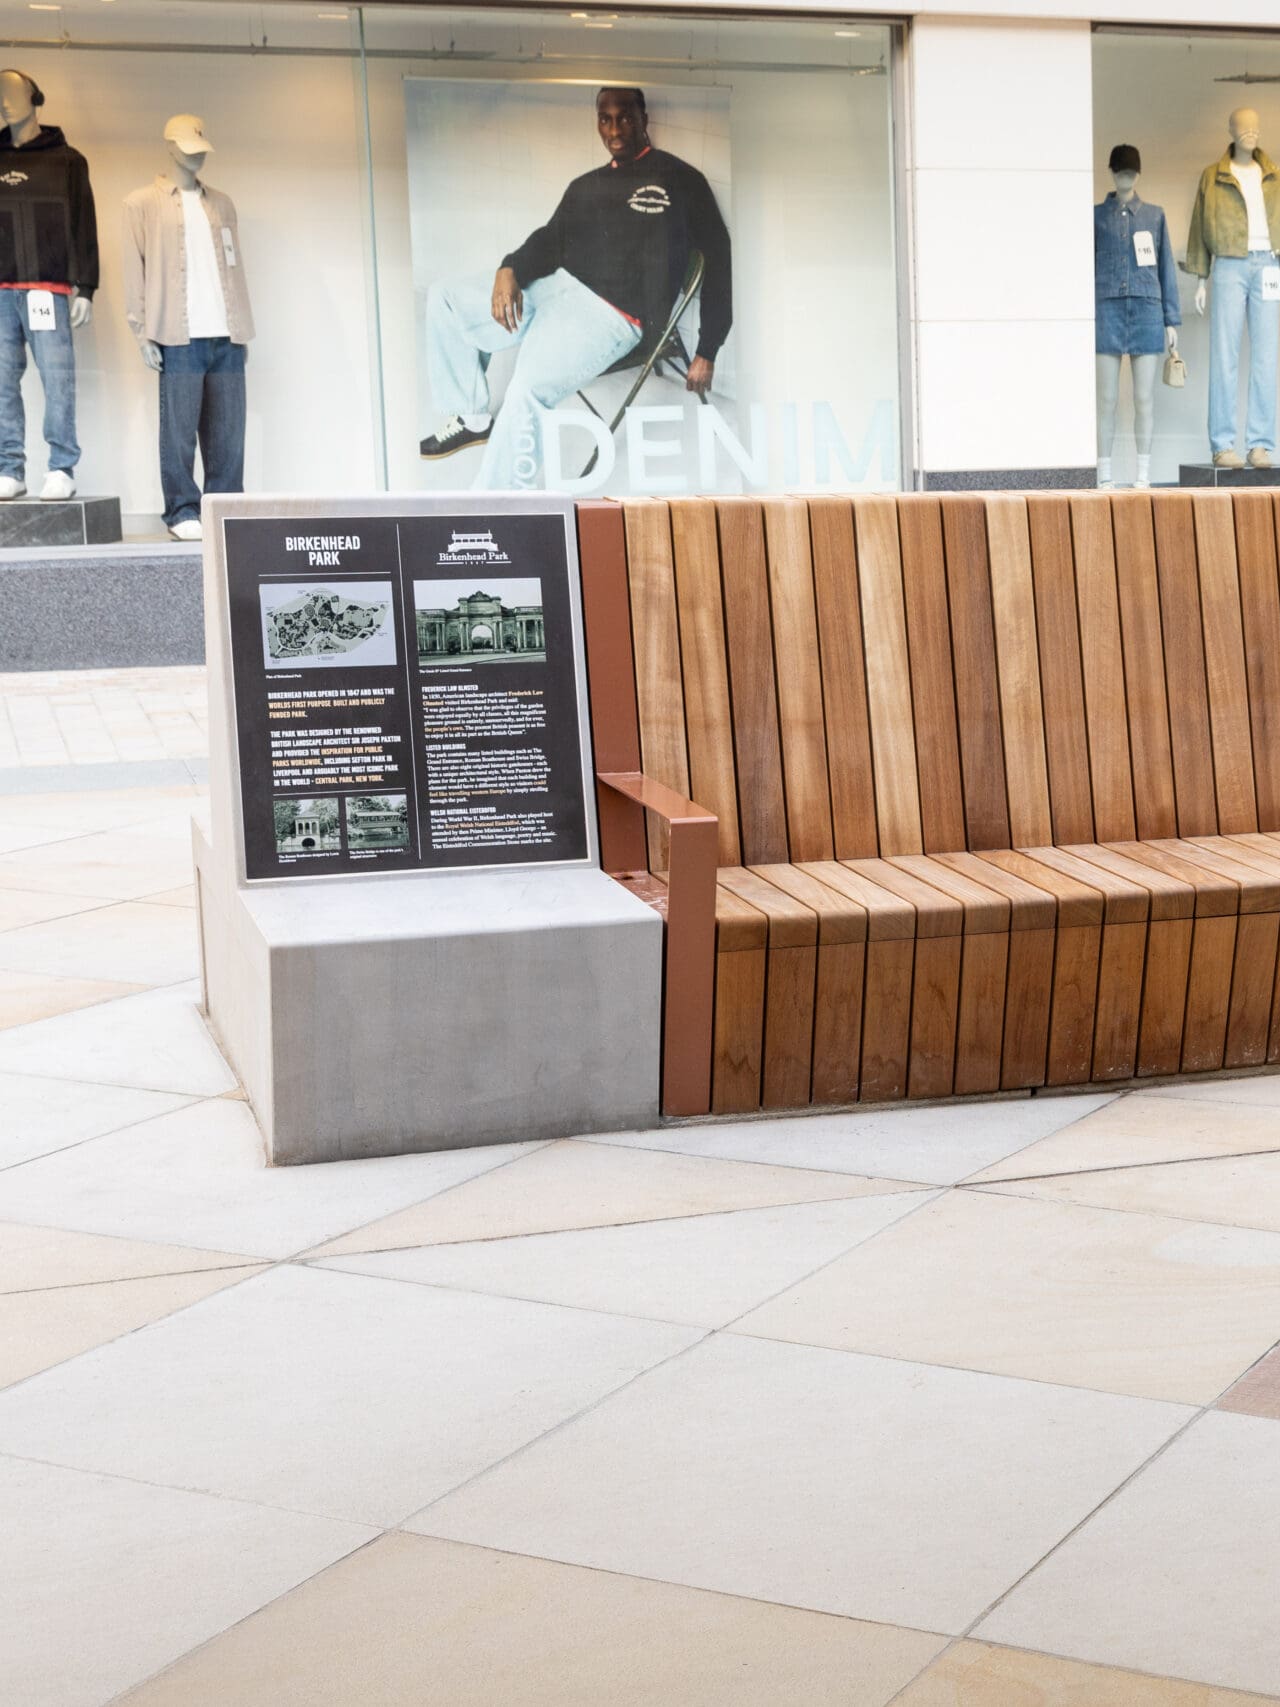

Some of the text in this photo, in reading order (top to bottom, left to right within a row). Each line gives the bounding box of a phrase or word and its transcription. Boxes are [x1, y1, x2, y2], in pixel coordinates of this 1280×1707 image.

[543, 399, 898, 493] DENIM
[285, 535, 361, 551] BIRKENHEAD
[308, 551, 340, 566] PARK
[439, 552, 509, 561] Birkenhead Park
[268, 691, 302, 700] BIRKENHEAD
[317, 690, 339, 698] OPENED
[340, 689, 346, 697] IN
[360, 688, 372, 696] AND
[333, 699, 348, 707] BUILT
[281, 730, 296, 738] PARK
[292, 739, 322, 747] LANDSCAPE
[323, 737, 350, 746] ARCHITECT
[361, 736, 380, 744] JOSEPH
[381, 735, 401, 743] PAXTON
[272, 745, 383, 758] AND PROVIDED THE INSPIRATION FOR PUBLIC
[273, 769, 301, 777] LIVERPOOL
[302, 768, 313, 776] AND
[341, 766, 350, 774] THE
[385, 764, 398, 772] PARK
[274, 779, 280, 787] IN
[292, 778, 310, 786] WORLD
[315, 777, 337, 785] CENTRAL
[369, 774, 384, 782] YORK.
